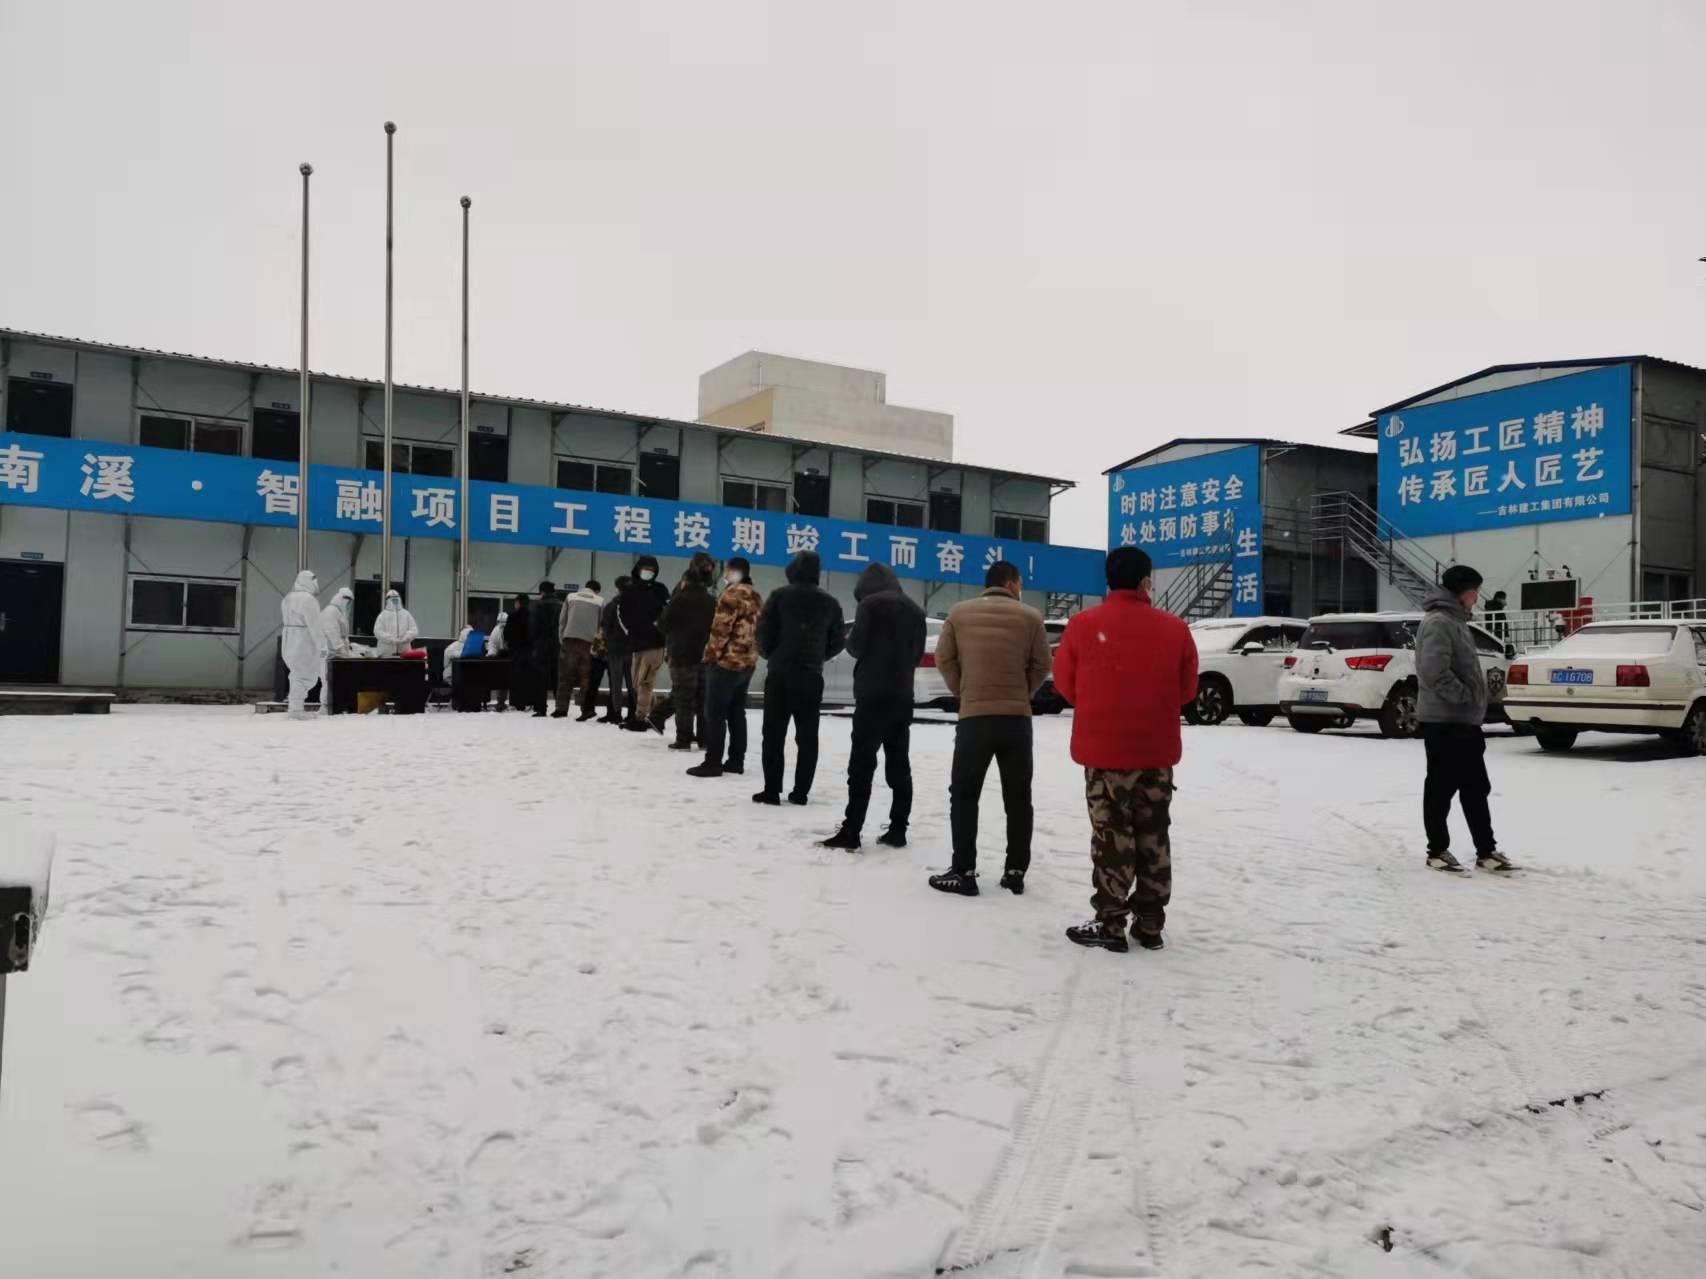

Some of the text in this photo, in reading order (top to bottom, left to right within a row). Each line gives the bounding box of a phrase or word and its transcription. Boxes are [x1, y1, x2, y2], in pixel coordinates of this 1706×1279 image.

[1399, 402, 1605, 467] 弘扬工匠精神
[1120, 474, 1244, 515] 时时注意安全
[1398, 447, 1605, 506] 传承匠人匠艺
[1235, 527, 1259, 603] 生活
